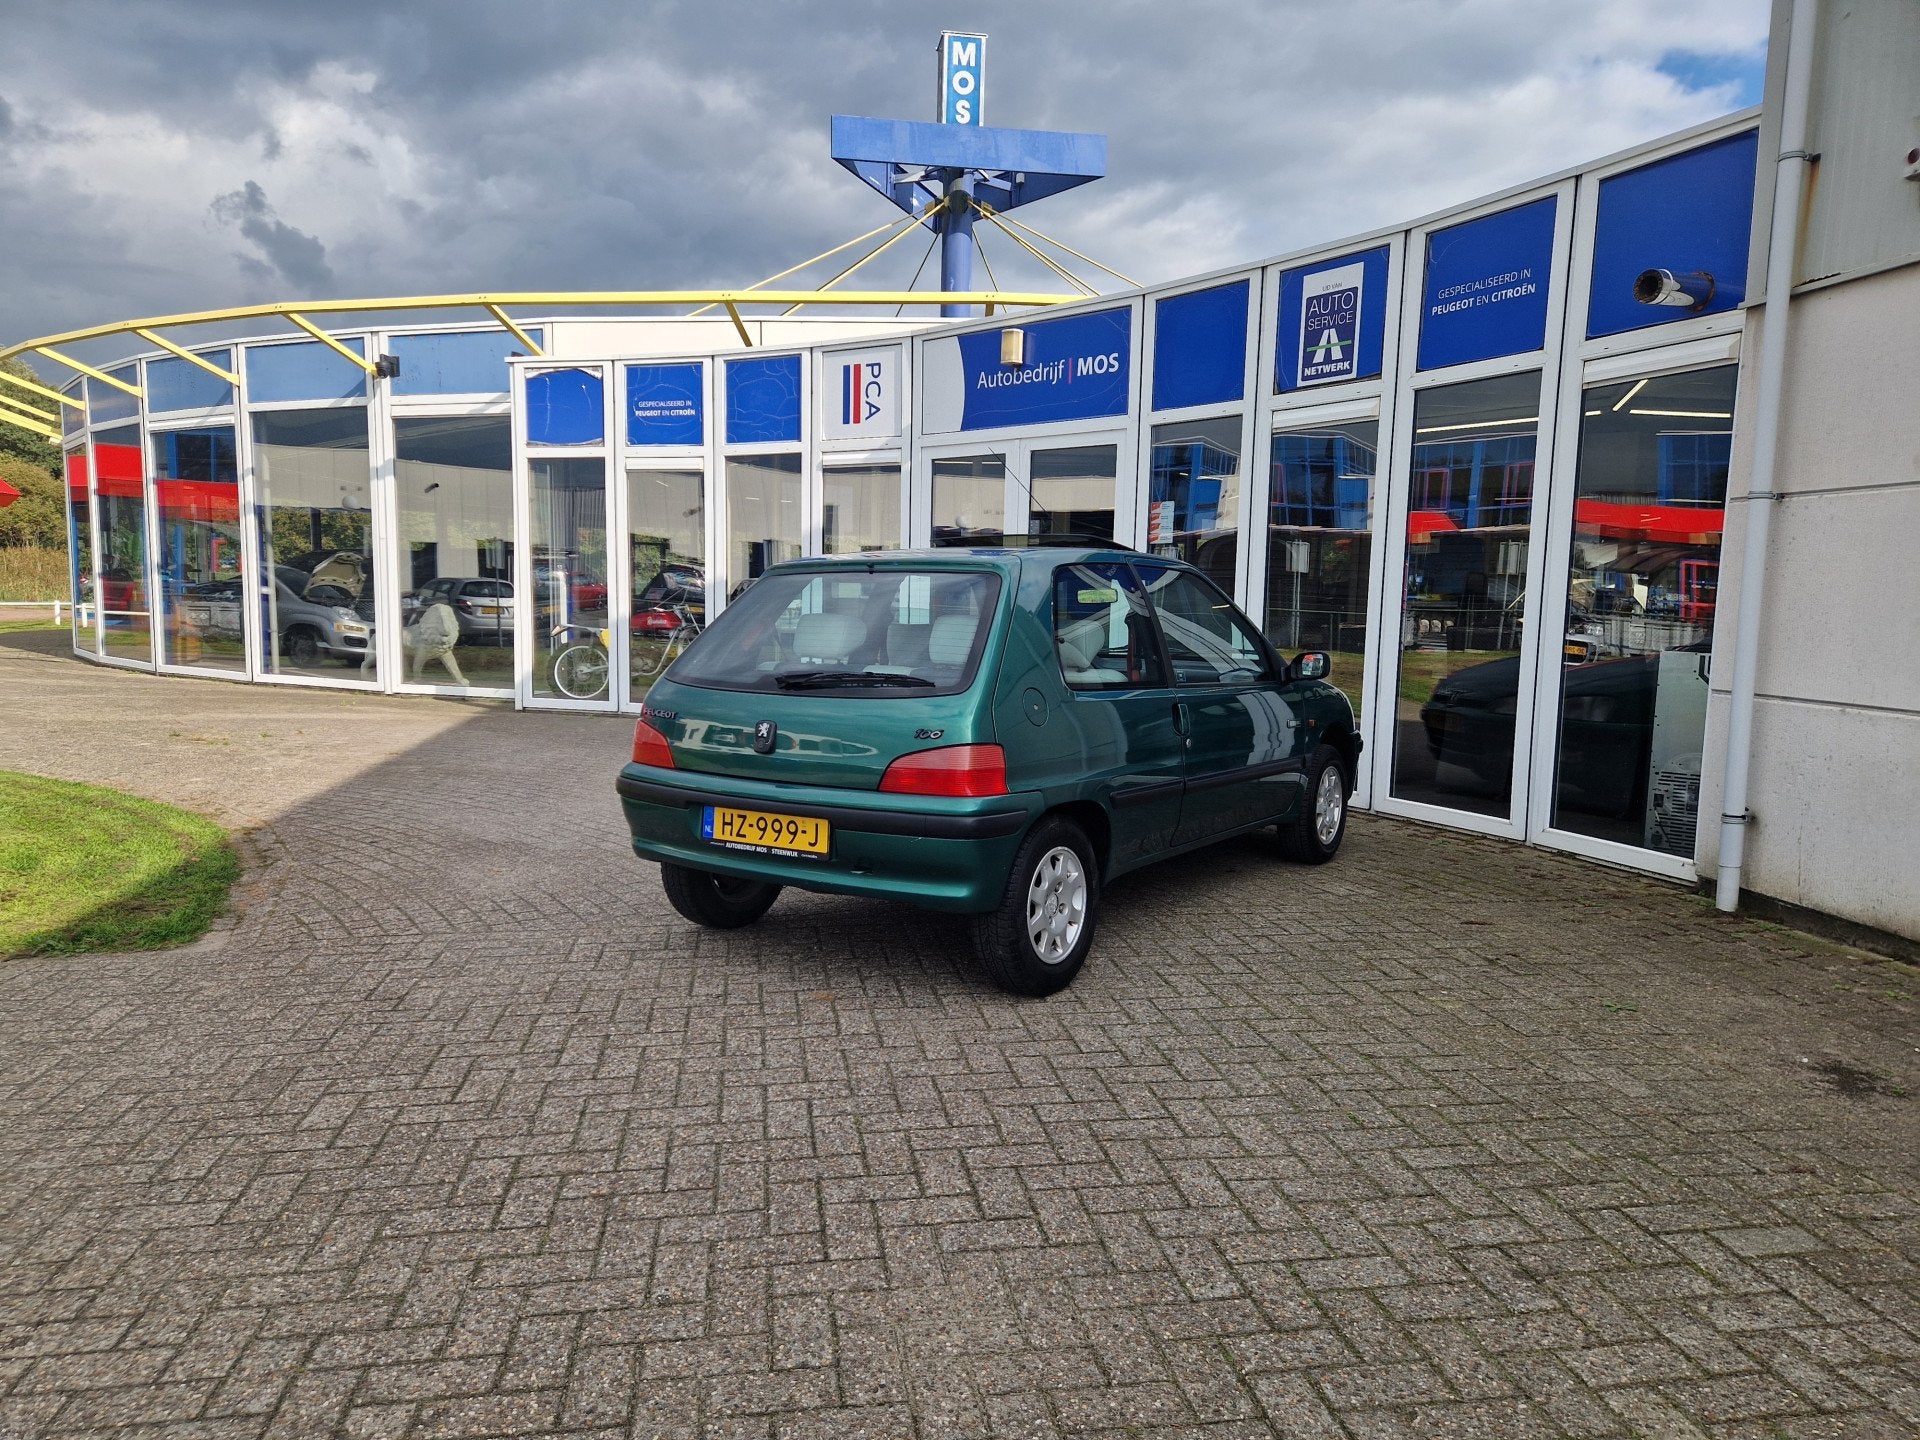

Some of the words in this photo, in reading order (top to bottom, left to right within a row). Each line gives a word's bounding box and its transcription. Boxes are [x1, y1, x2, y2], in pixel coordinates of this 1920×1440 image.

[952, 41, 976, 125] MOS
[1438, 271, 1517, 299] GESPECIALISEERD
[1520, 268, 1531, 280] IN
[1308, 291, 1354, 316] AUTO
[1431, 297, 1474, 316] PEUGEOT
[1476, 294, 1489, 306] EN
[1491, 282, 1536, 302] CITROËN
[1307, 310, 1354, 331] SERVICE
[977, 359, 1065, 389] Autobedrijf
[1077, 352, 1119, 377] MOS
[1304, 360, 1351, 377] NETWERK
[865, 362, 881, 420] PCA
[644, 708, 676, 719] PEUGEOT
[704, 825, 713, 833] NL
[721, 812, 819, 848] HZ-999-J
[725, 841, 756, 852] AUTOBEDRIJF
[756, 845, 767, 853] MOS
[771, 848, 799, 858] STEENWIJK
